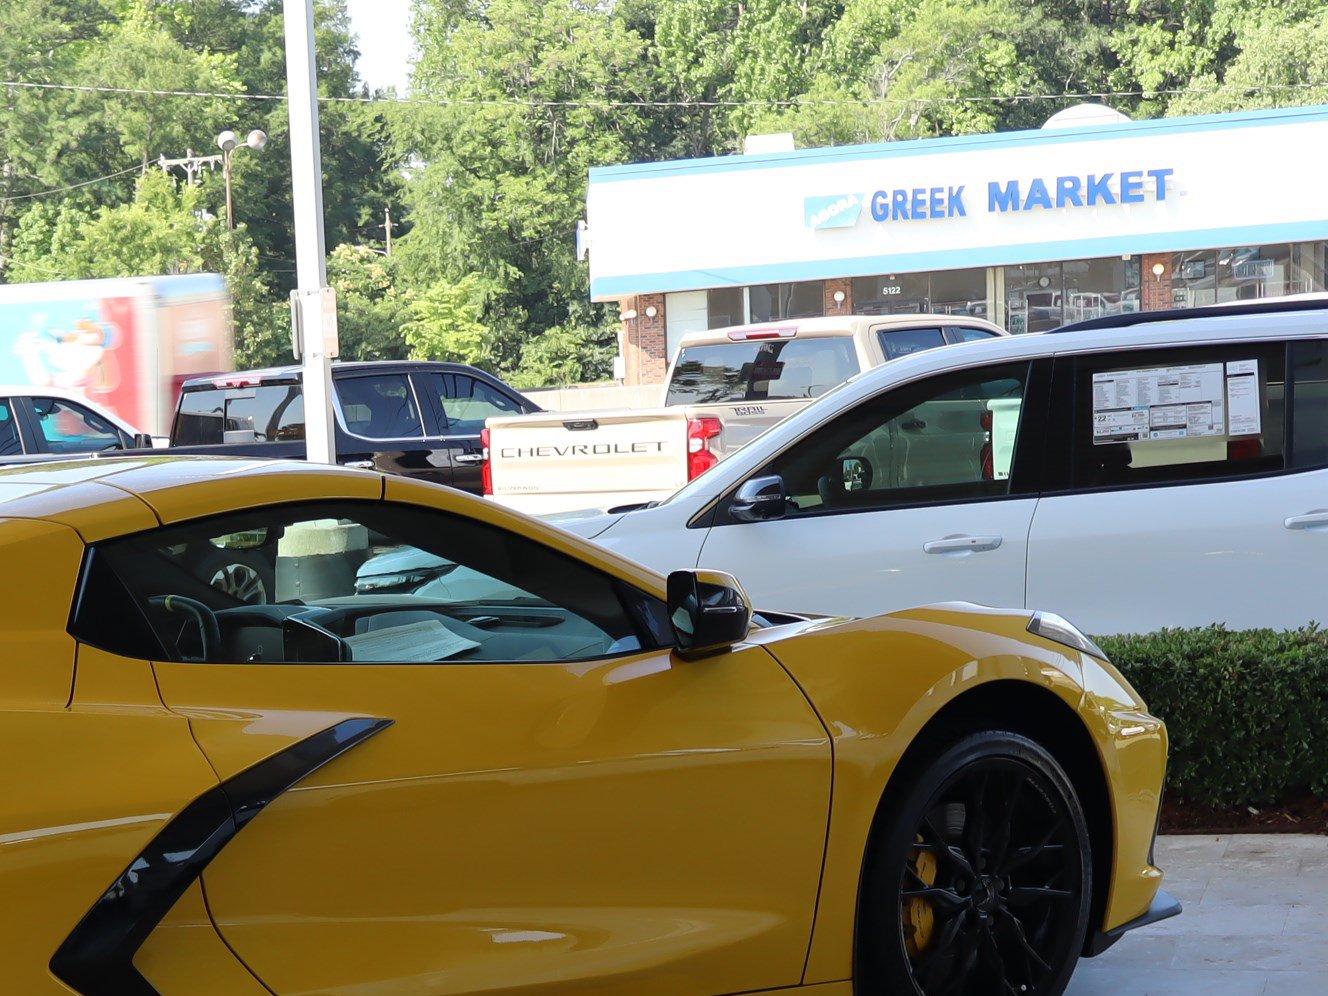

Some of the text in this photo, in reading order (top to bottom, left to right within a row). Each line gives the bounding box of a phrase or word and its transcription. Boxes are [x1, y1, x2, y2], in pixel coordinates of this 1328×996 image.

[871, 185, 967, 222] GREEK
[988, 168, 1174, 212] MARKET
[882, 286, 901, 296] 5122
[501, 441, 670, 459] CHEVROLET
